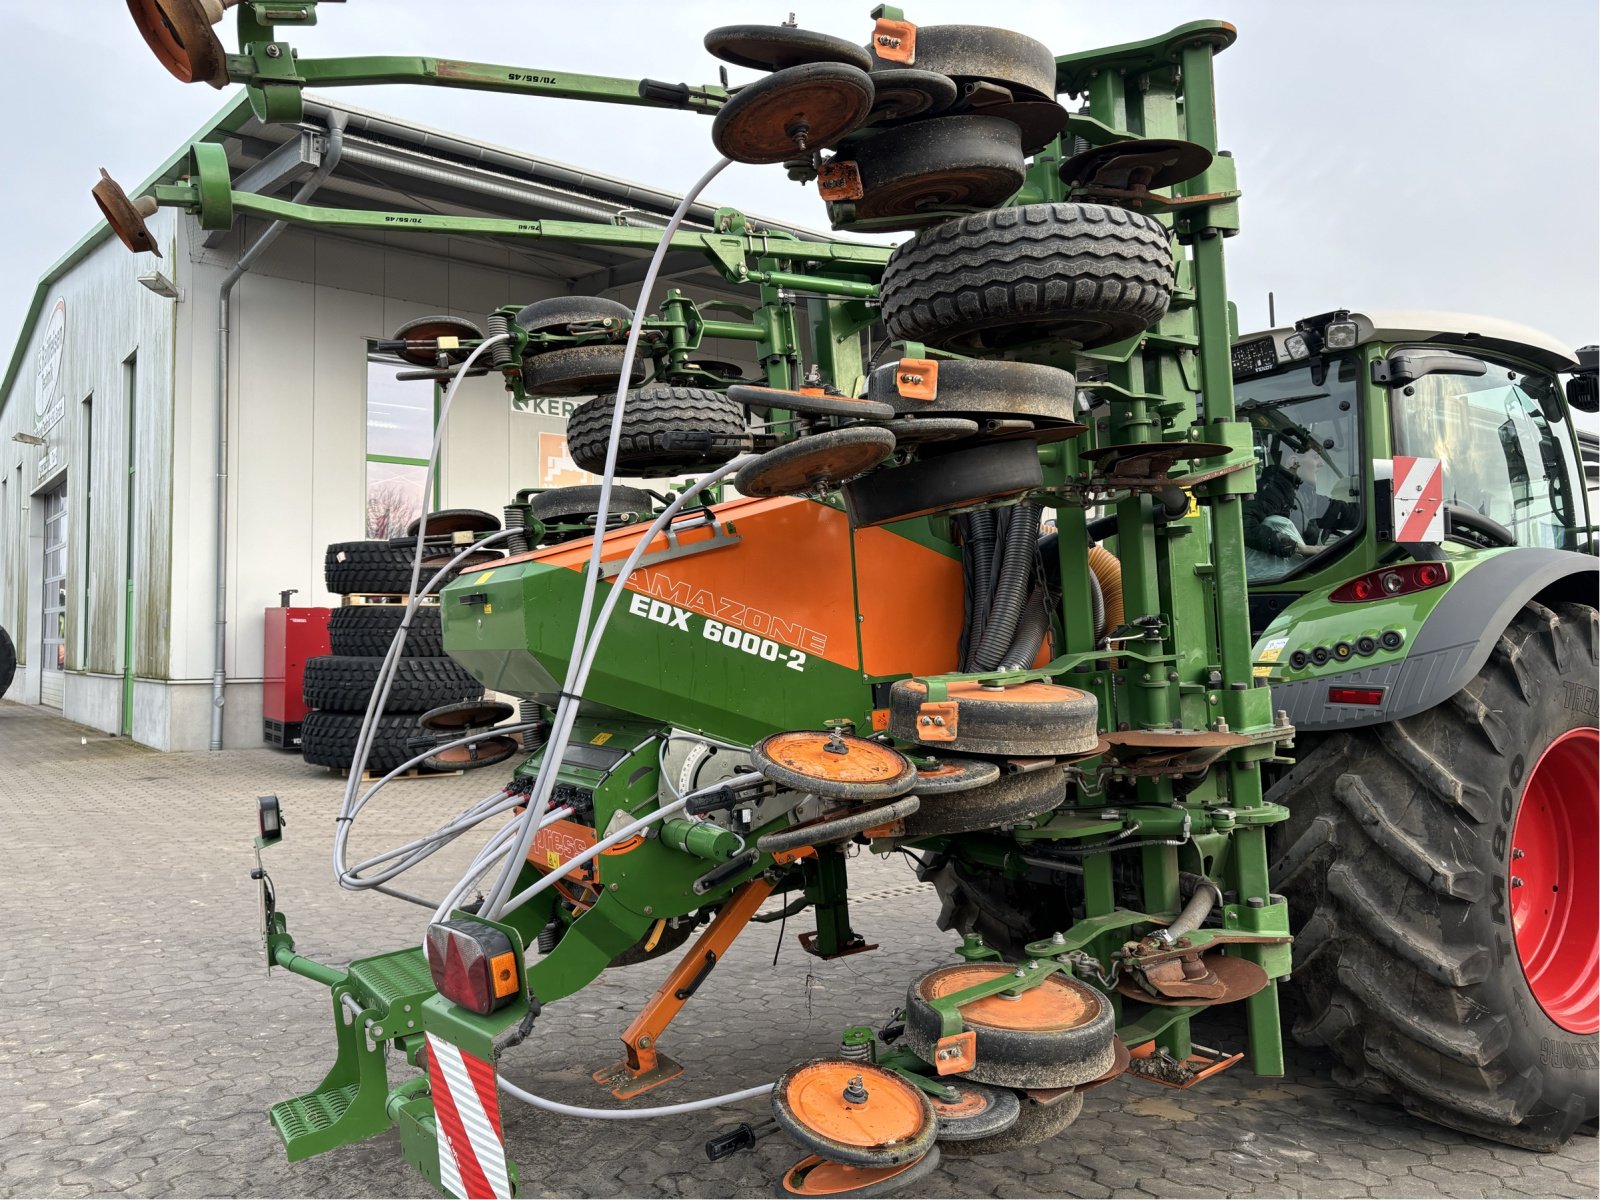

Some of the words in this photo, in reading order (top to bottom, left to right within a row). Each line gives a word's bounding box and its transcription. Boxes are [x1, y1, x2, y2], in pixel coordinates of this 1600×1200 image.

[508, 73, 557, 84] 70/55/45
[533, 398, 580, 417] KER
[626, 568, 828, 656] AMAZONE
[629, 593, 692, 632] EDX
[703, 619, 806, 672] 6000-2
